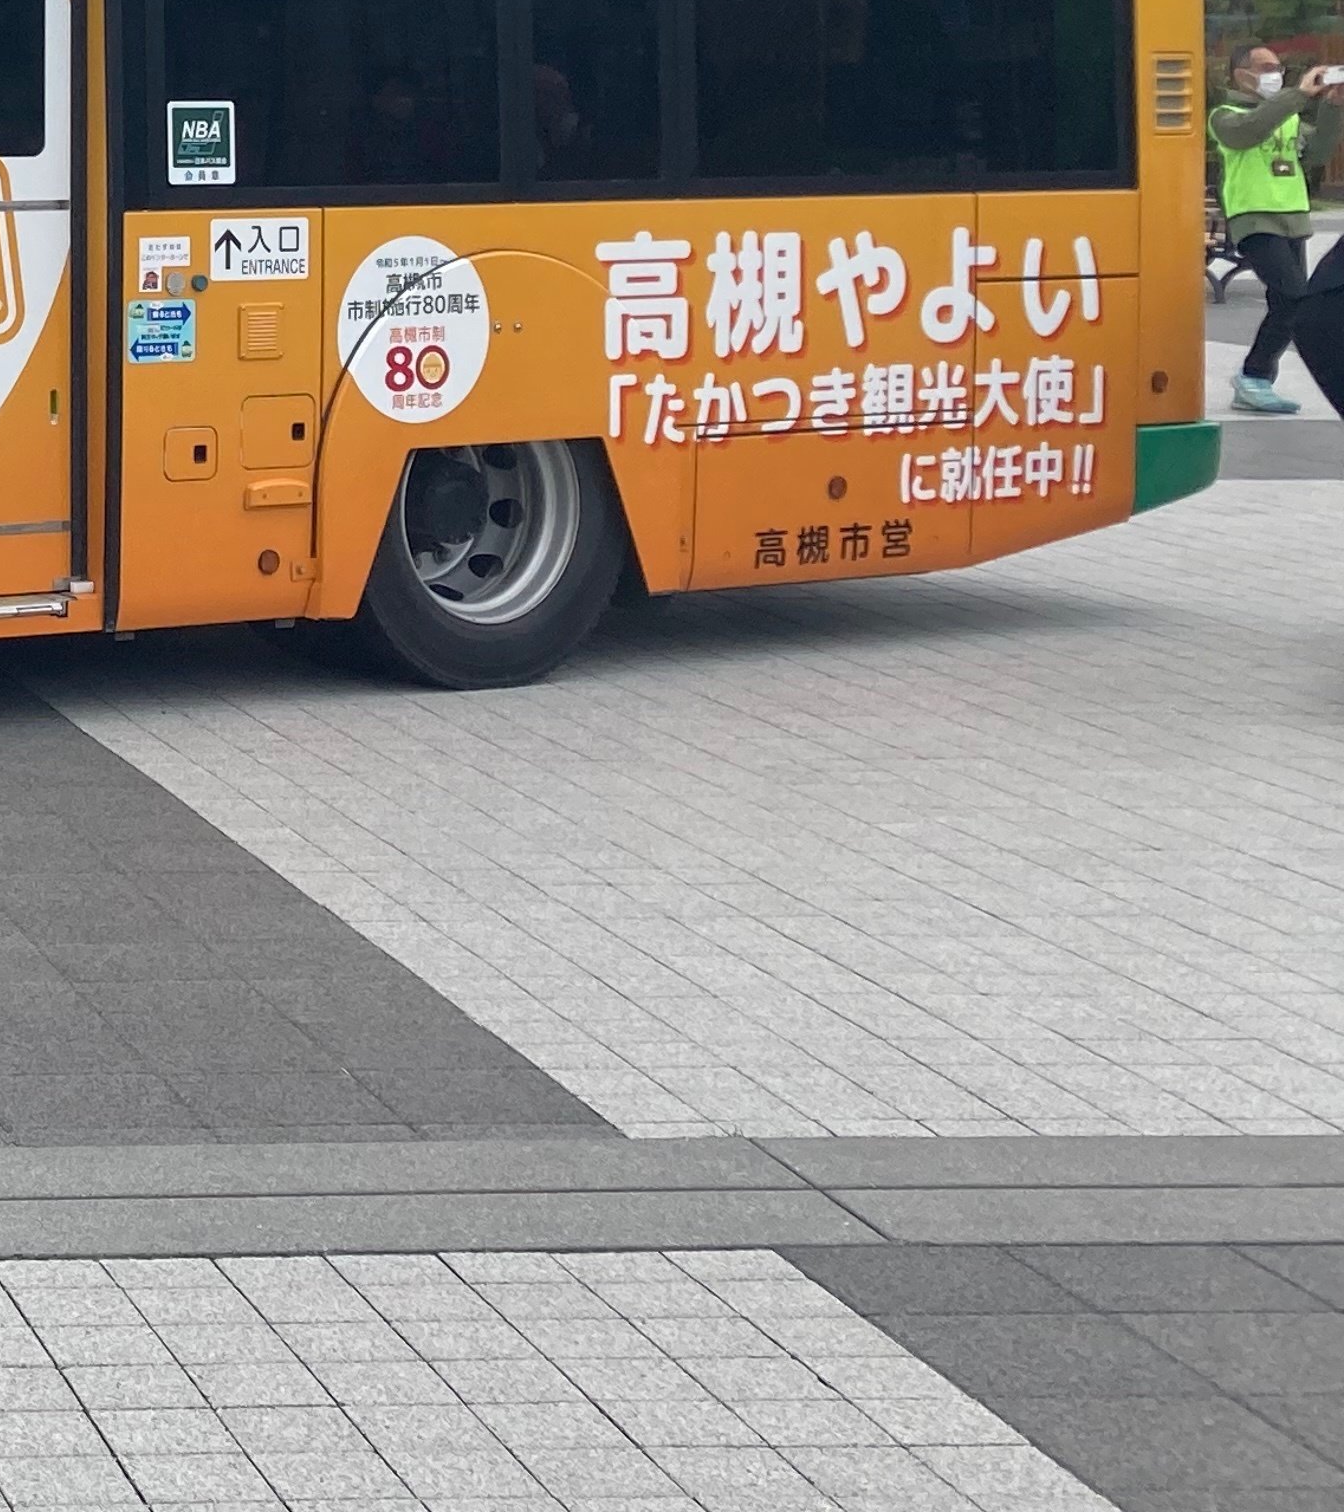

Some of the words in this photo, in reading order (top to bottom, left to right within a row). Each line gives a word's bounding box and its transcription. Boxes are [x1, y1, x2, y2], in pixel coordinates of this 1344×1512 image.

[182, 120, 221, 138] NBA
[248, 225, 300, 253] 入口
[241, 258, 306, 275] ENTRANCE
[347, 293, 480, 321] 市制施行80周年
[596, 226, 1101, 360] 高槻やよい
[385, 344, 450, 392] 80
[753, 519, 914, 570] 高槻市営
